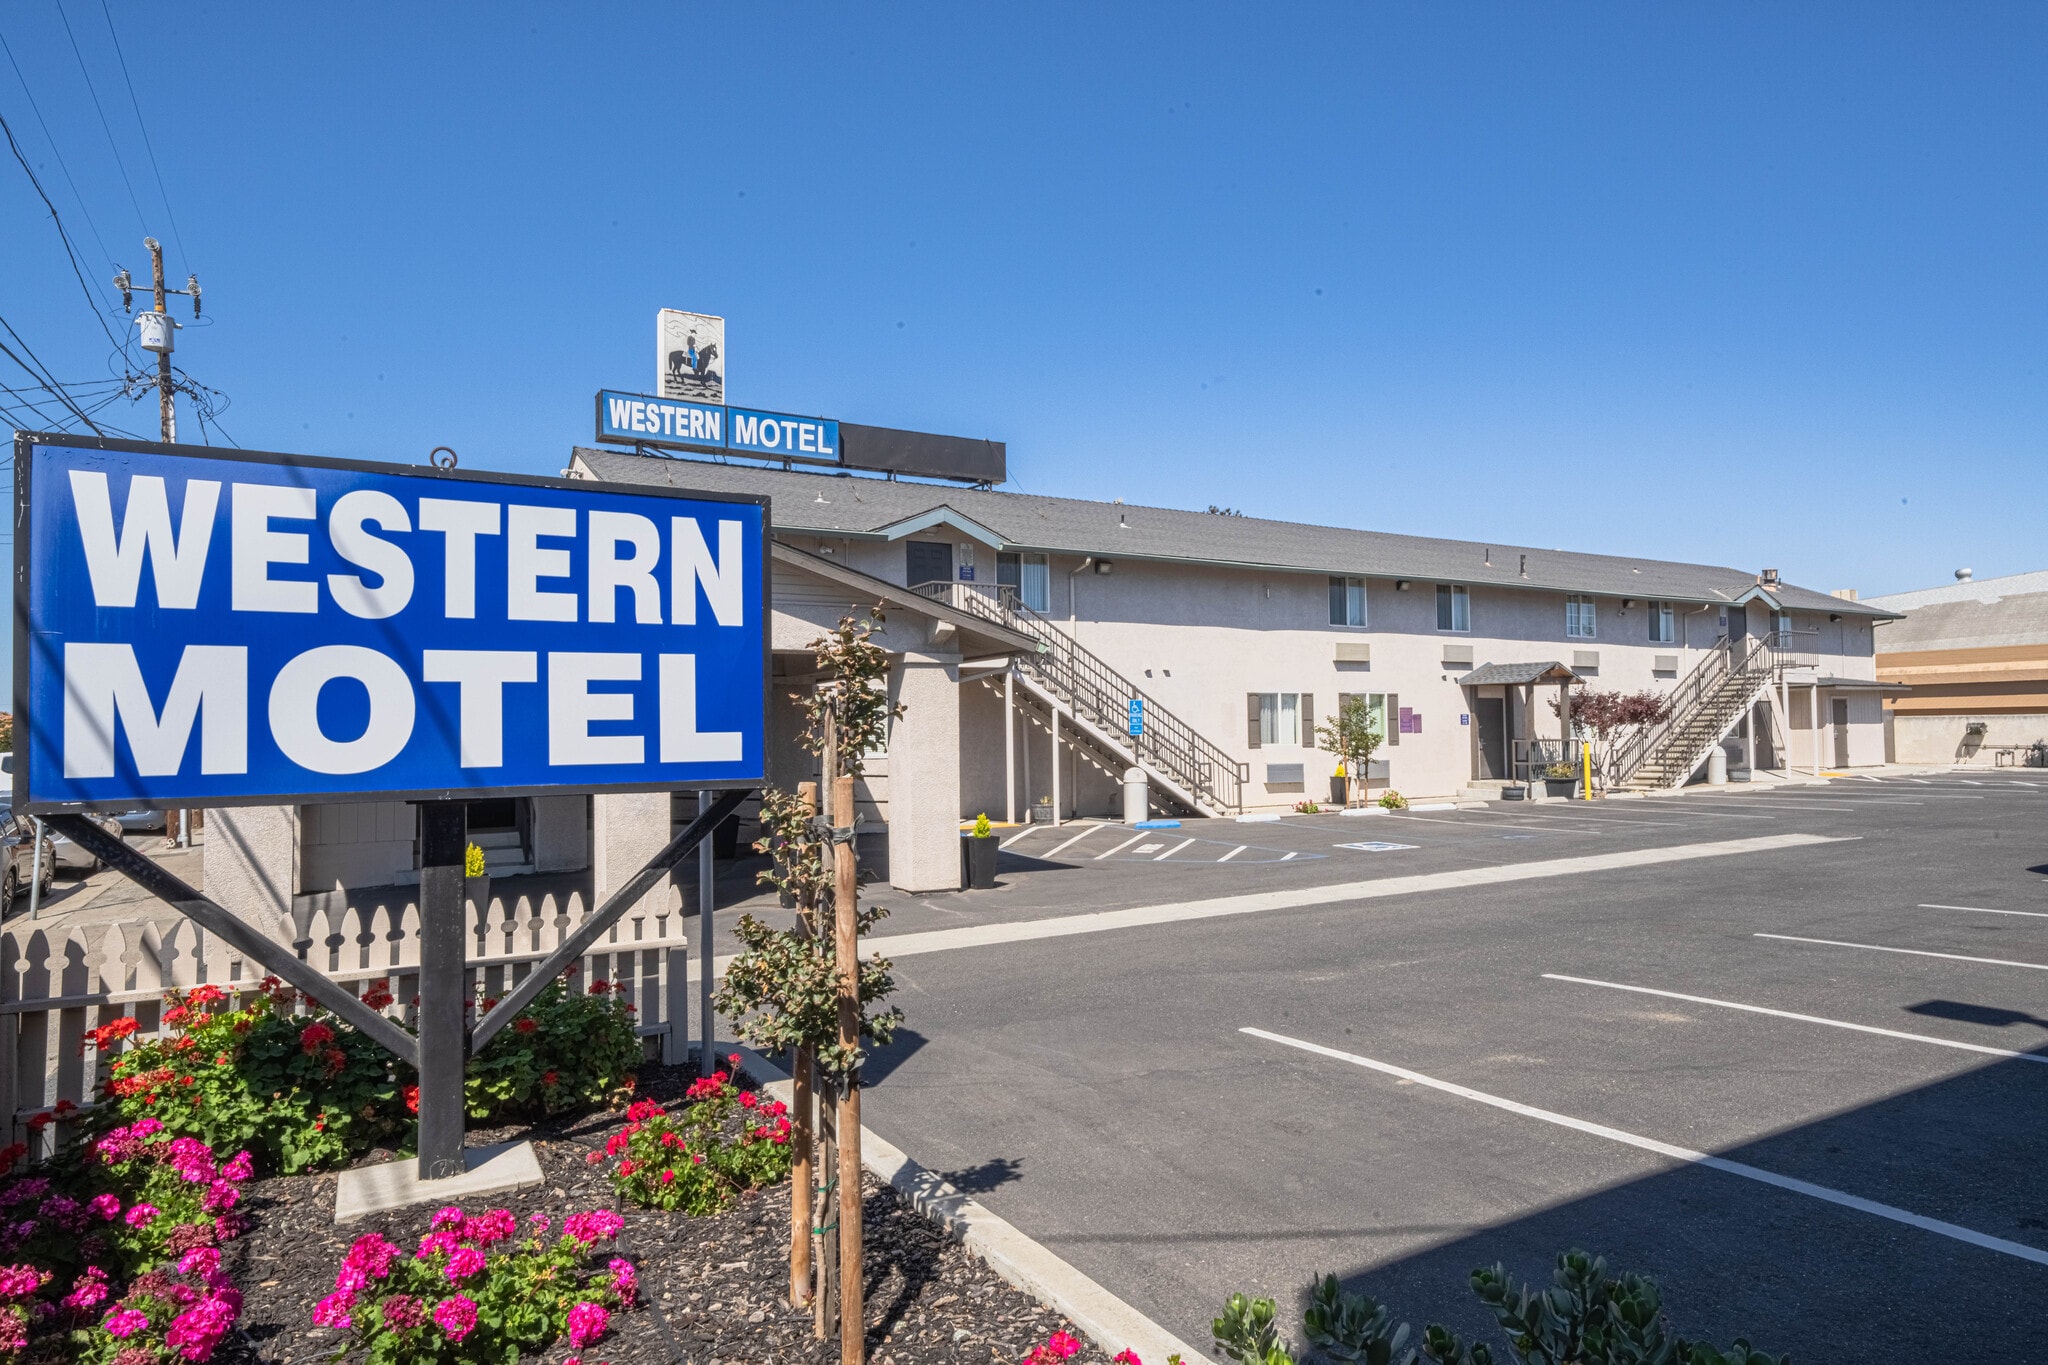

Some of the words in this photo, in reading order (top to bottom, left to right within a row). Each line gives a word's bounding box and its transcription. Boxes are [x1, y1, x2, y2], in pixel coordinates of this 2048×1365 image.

[609, 398, 720, 441] WESTERN
[735, 414, 833, 454] MOTEL
[68, 470, 743, 627] WESTERN
[64, 643, 743, 779] MOTEL
